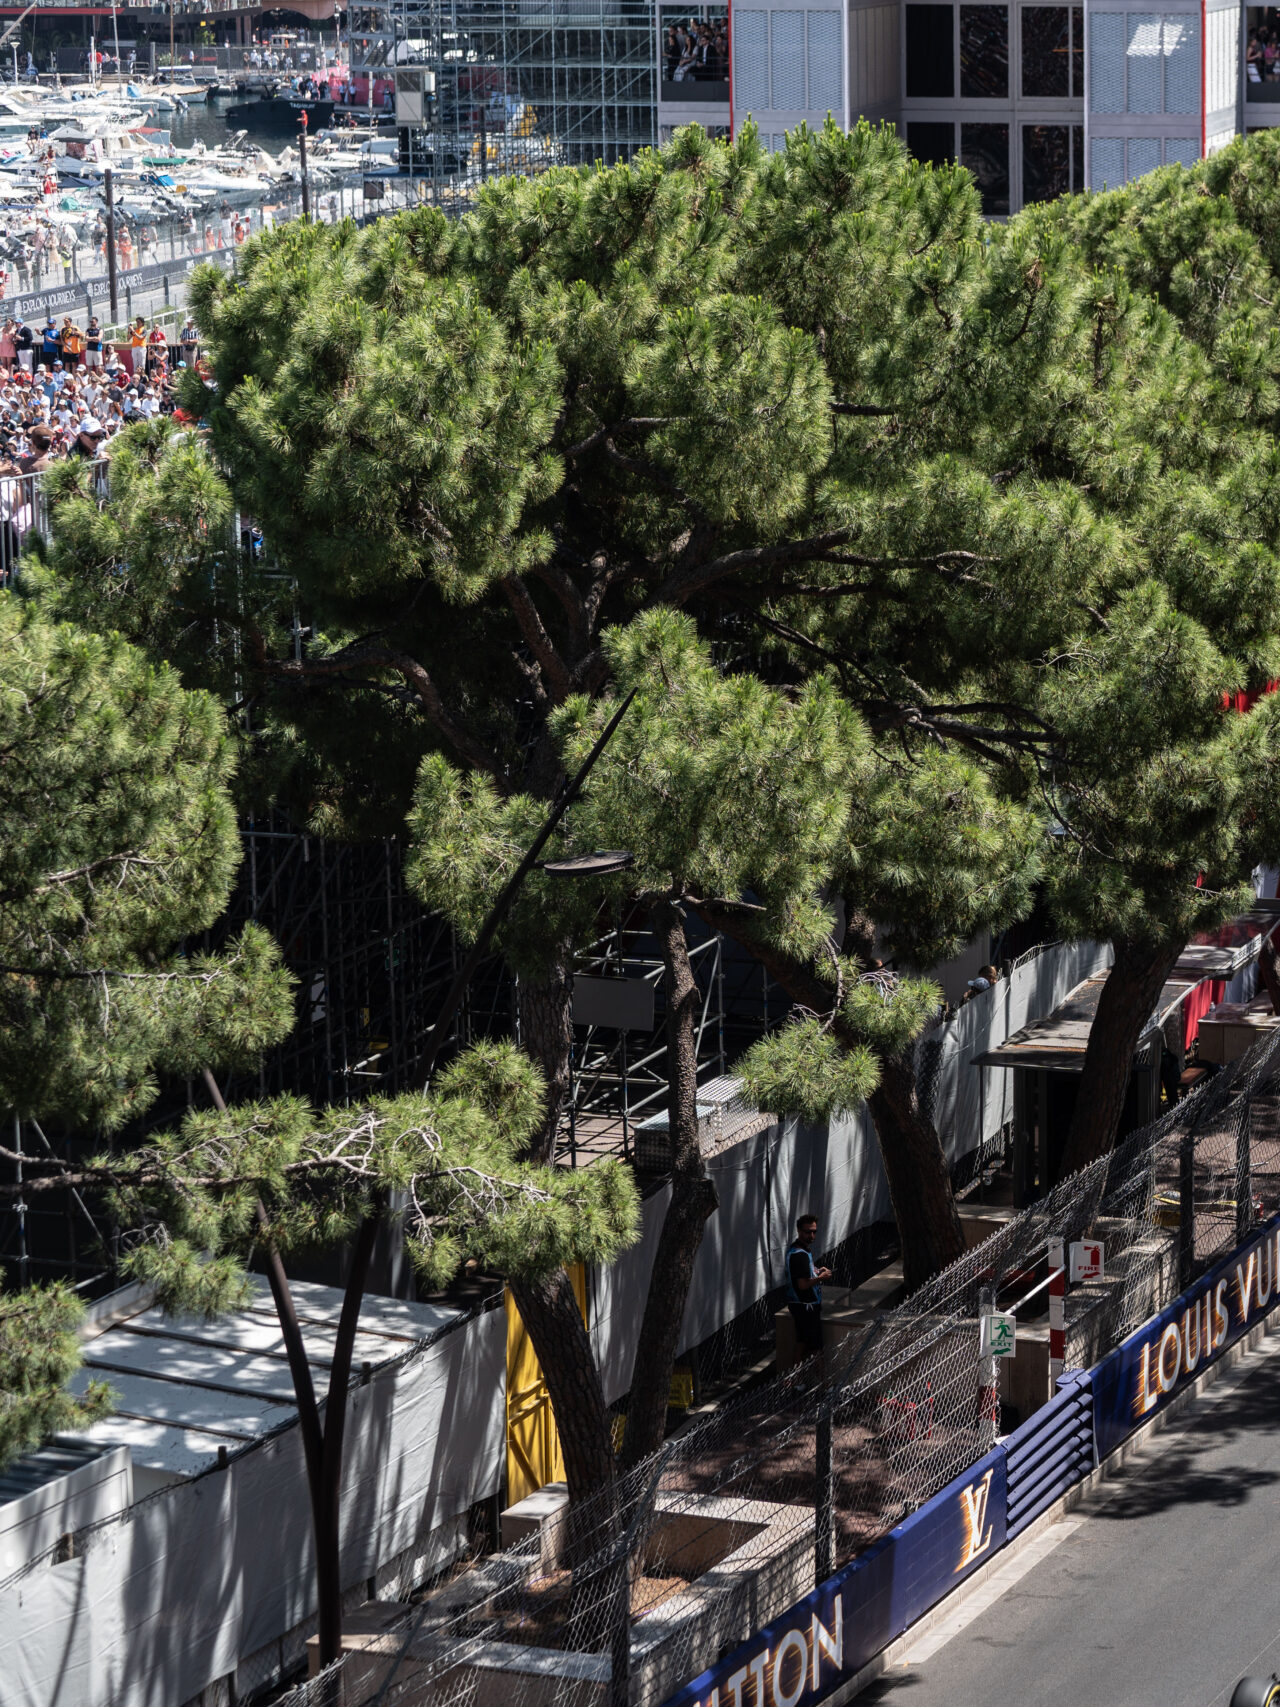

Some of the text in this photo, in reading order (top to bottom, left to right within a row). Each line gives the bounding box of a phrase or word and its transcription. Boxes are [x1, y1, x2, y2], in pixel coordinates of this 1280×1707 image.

[1077, 1263, 1101, 1271] FIRE
[1133, 1276, 1231, 1419] LOUIS
[692, 1592, 844, 1707] TTON
